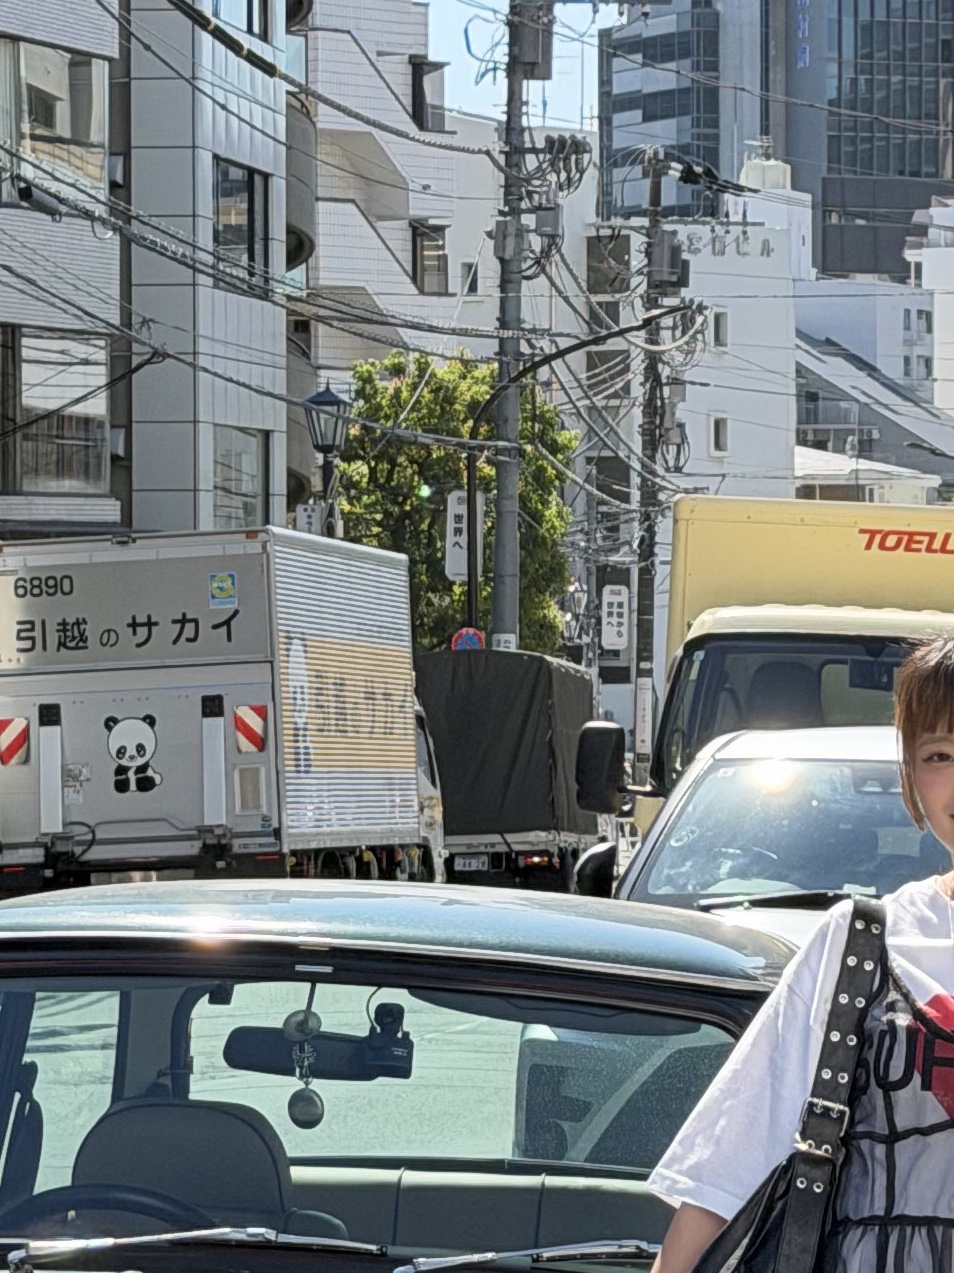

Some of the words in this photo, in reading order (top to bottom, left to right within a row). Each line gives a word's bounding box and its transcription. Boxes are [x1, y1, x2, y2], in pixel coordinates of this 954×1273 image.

[14, 574, 74, 599] 6890
[15, 608, 240, 653] 引越のサカイ
